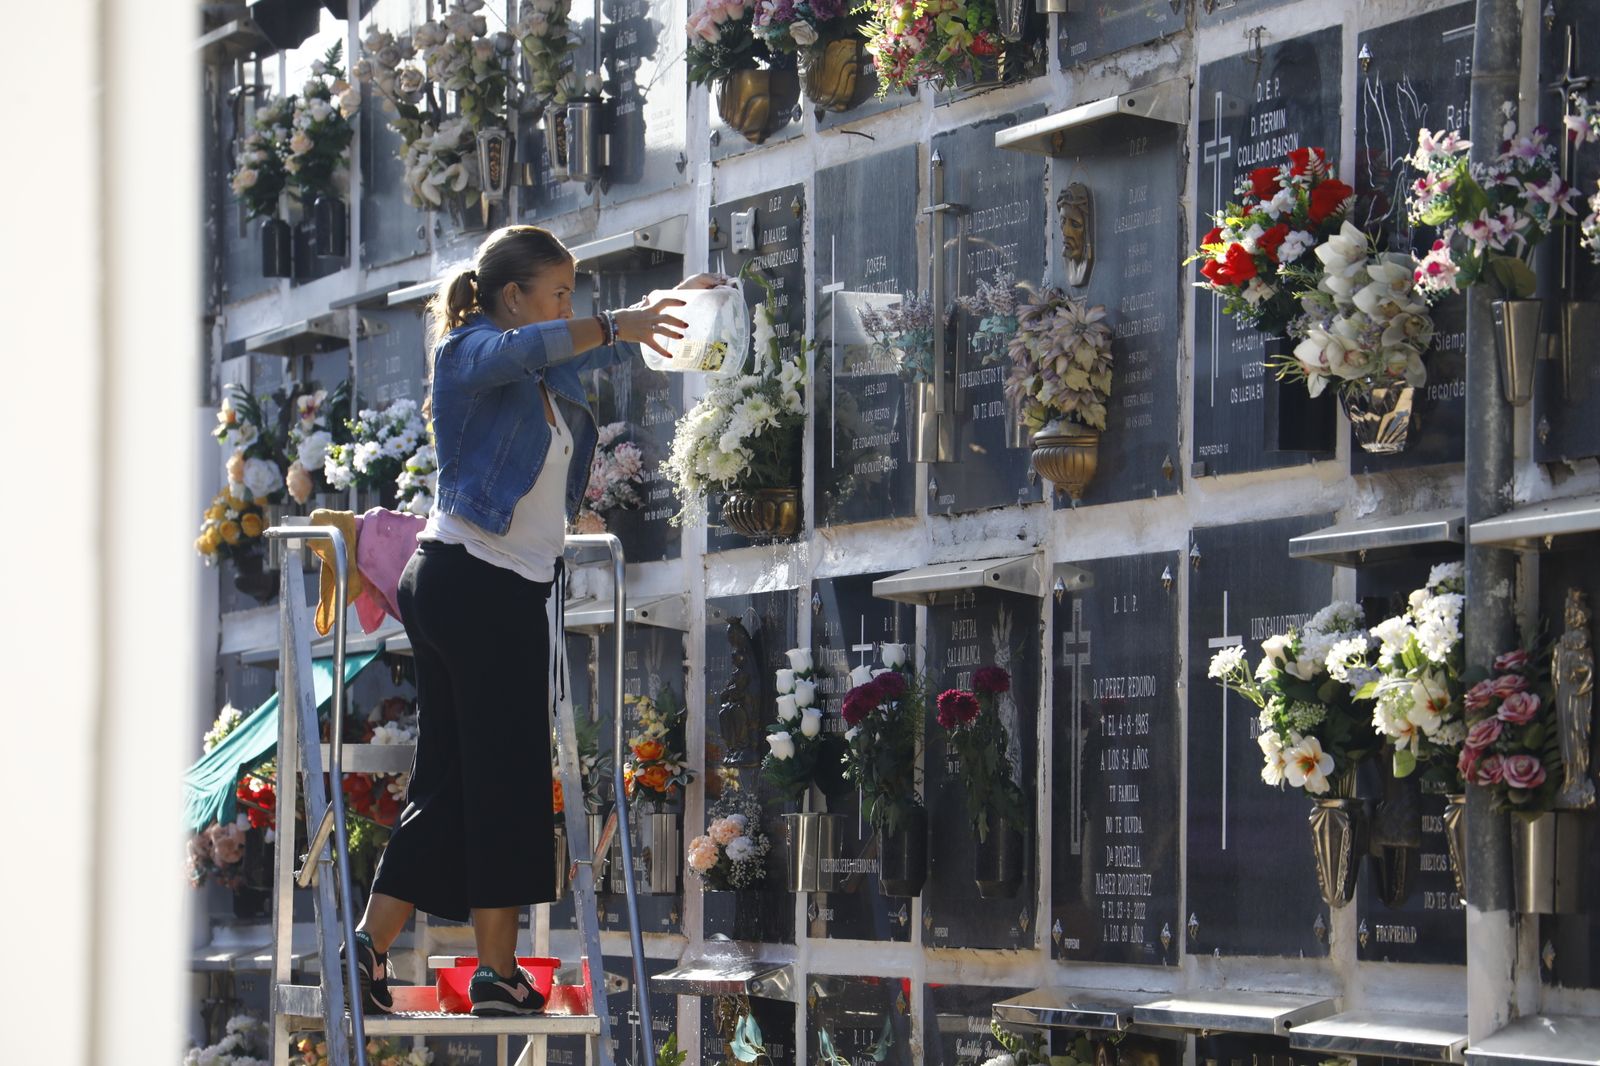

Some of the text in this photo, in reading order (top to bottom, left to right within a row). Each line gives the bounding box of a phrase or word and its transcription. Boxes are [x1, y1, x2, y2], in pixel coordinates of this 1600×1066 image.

[1259, 108, 1286, 134] FERMIN
[1237, 132, 1299, 167] COLLADO BAISON
[865, 256, 887, 278] JOSEFA
[1427, 376, 1465, 400] recorda
[1127, 674, 1156, 698] REDONDO
[1108, 749, 1119, 770] LOS
[1109, 784, 1140, 802] TU FAMILIA
[1106, 816, 1113, 833] NO
[1115, 816, 1122, 833] TE
[1118, 873, 1152, 896] RODRIGUEZ
[1110, 926, 1119, 942] LOS
[1376, 924, 1417, 943] PROPIEDAD
